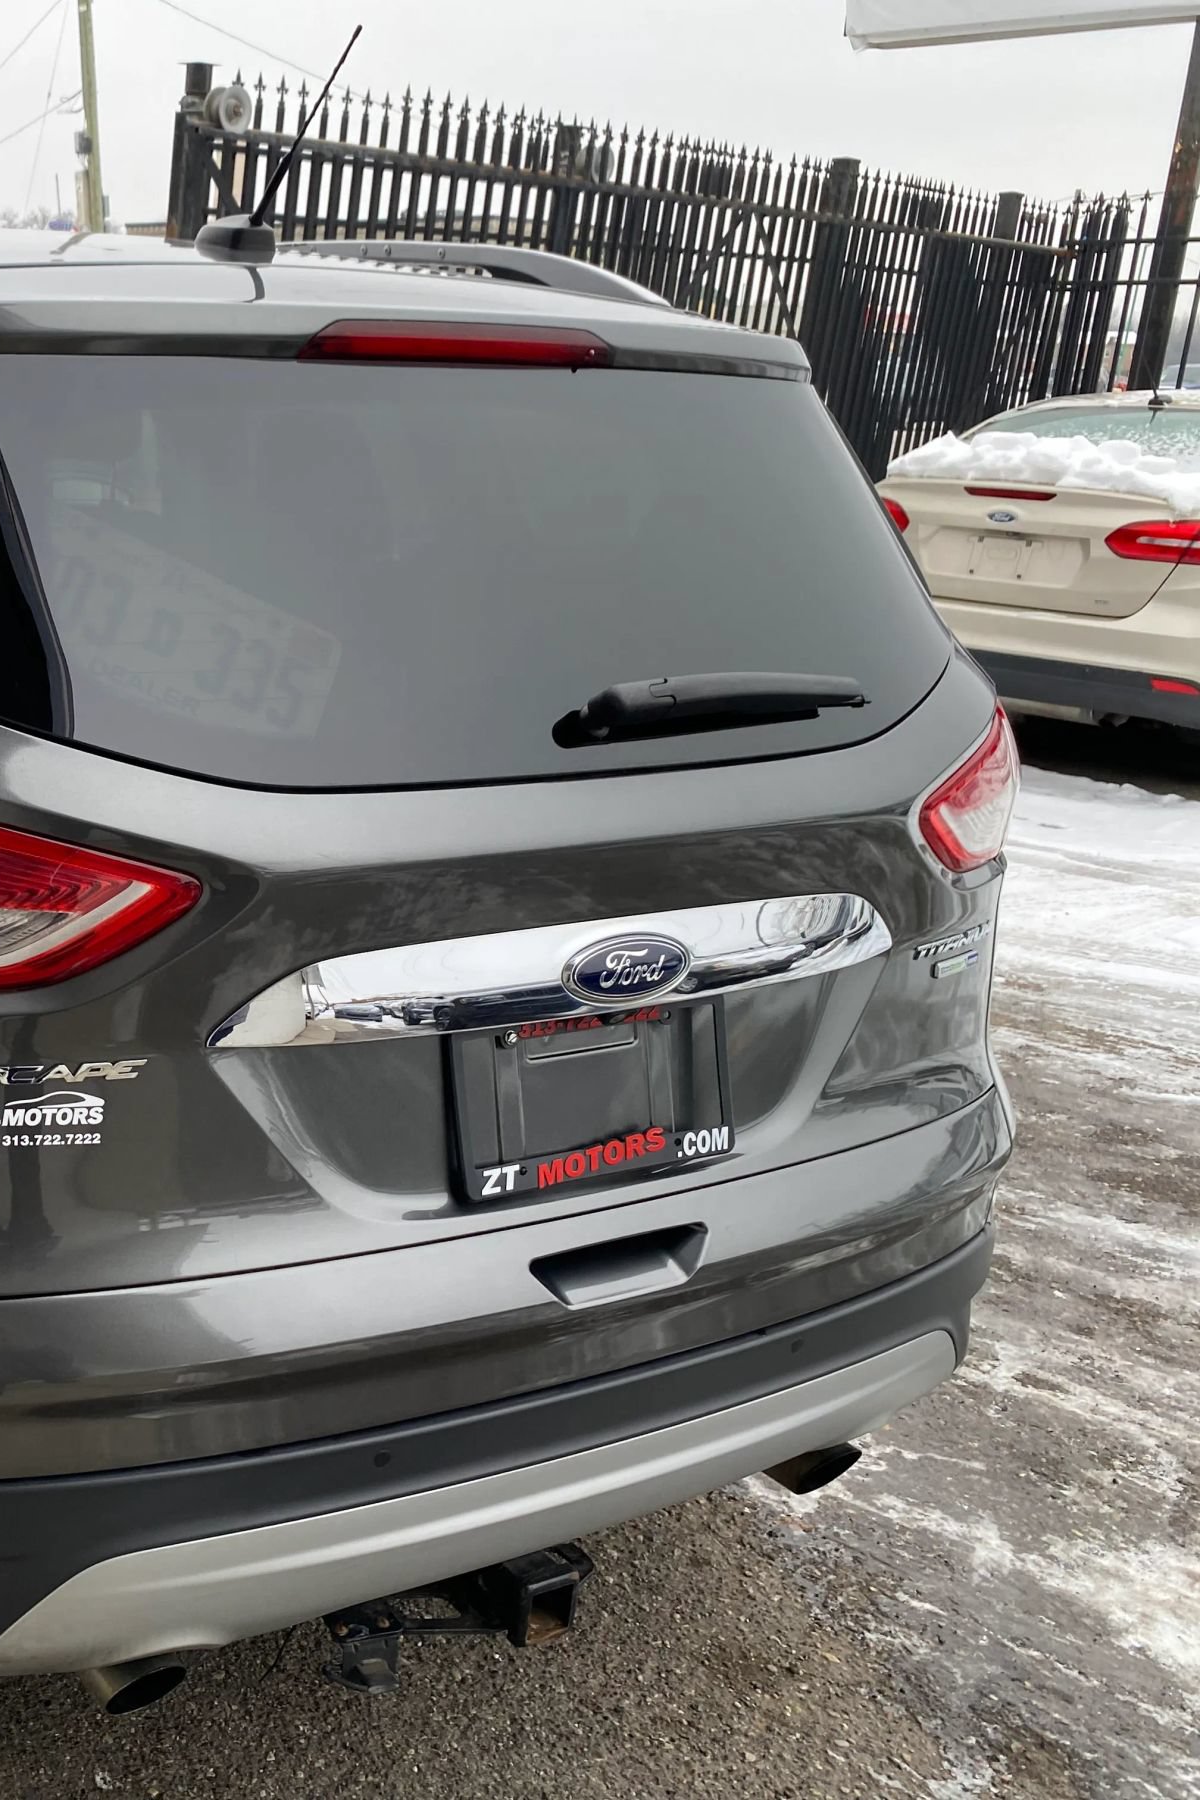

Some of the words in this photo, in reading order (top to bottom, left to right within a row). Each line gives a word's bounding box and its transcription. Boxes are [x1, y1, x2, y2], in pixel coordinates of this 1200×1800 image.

[599, 948, 666, 989] Ford
[0, 1105, 104, 1127] MOTORS
[1, 1132, 102, 1147] 313.722.7222
[481, 1163, 521, 1197] ZT
[536, 1126, 666, 1190] MOTORS
[676, 1125, 730, 1158] .COM
